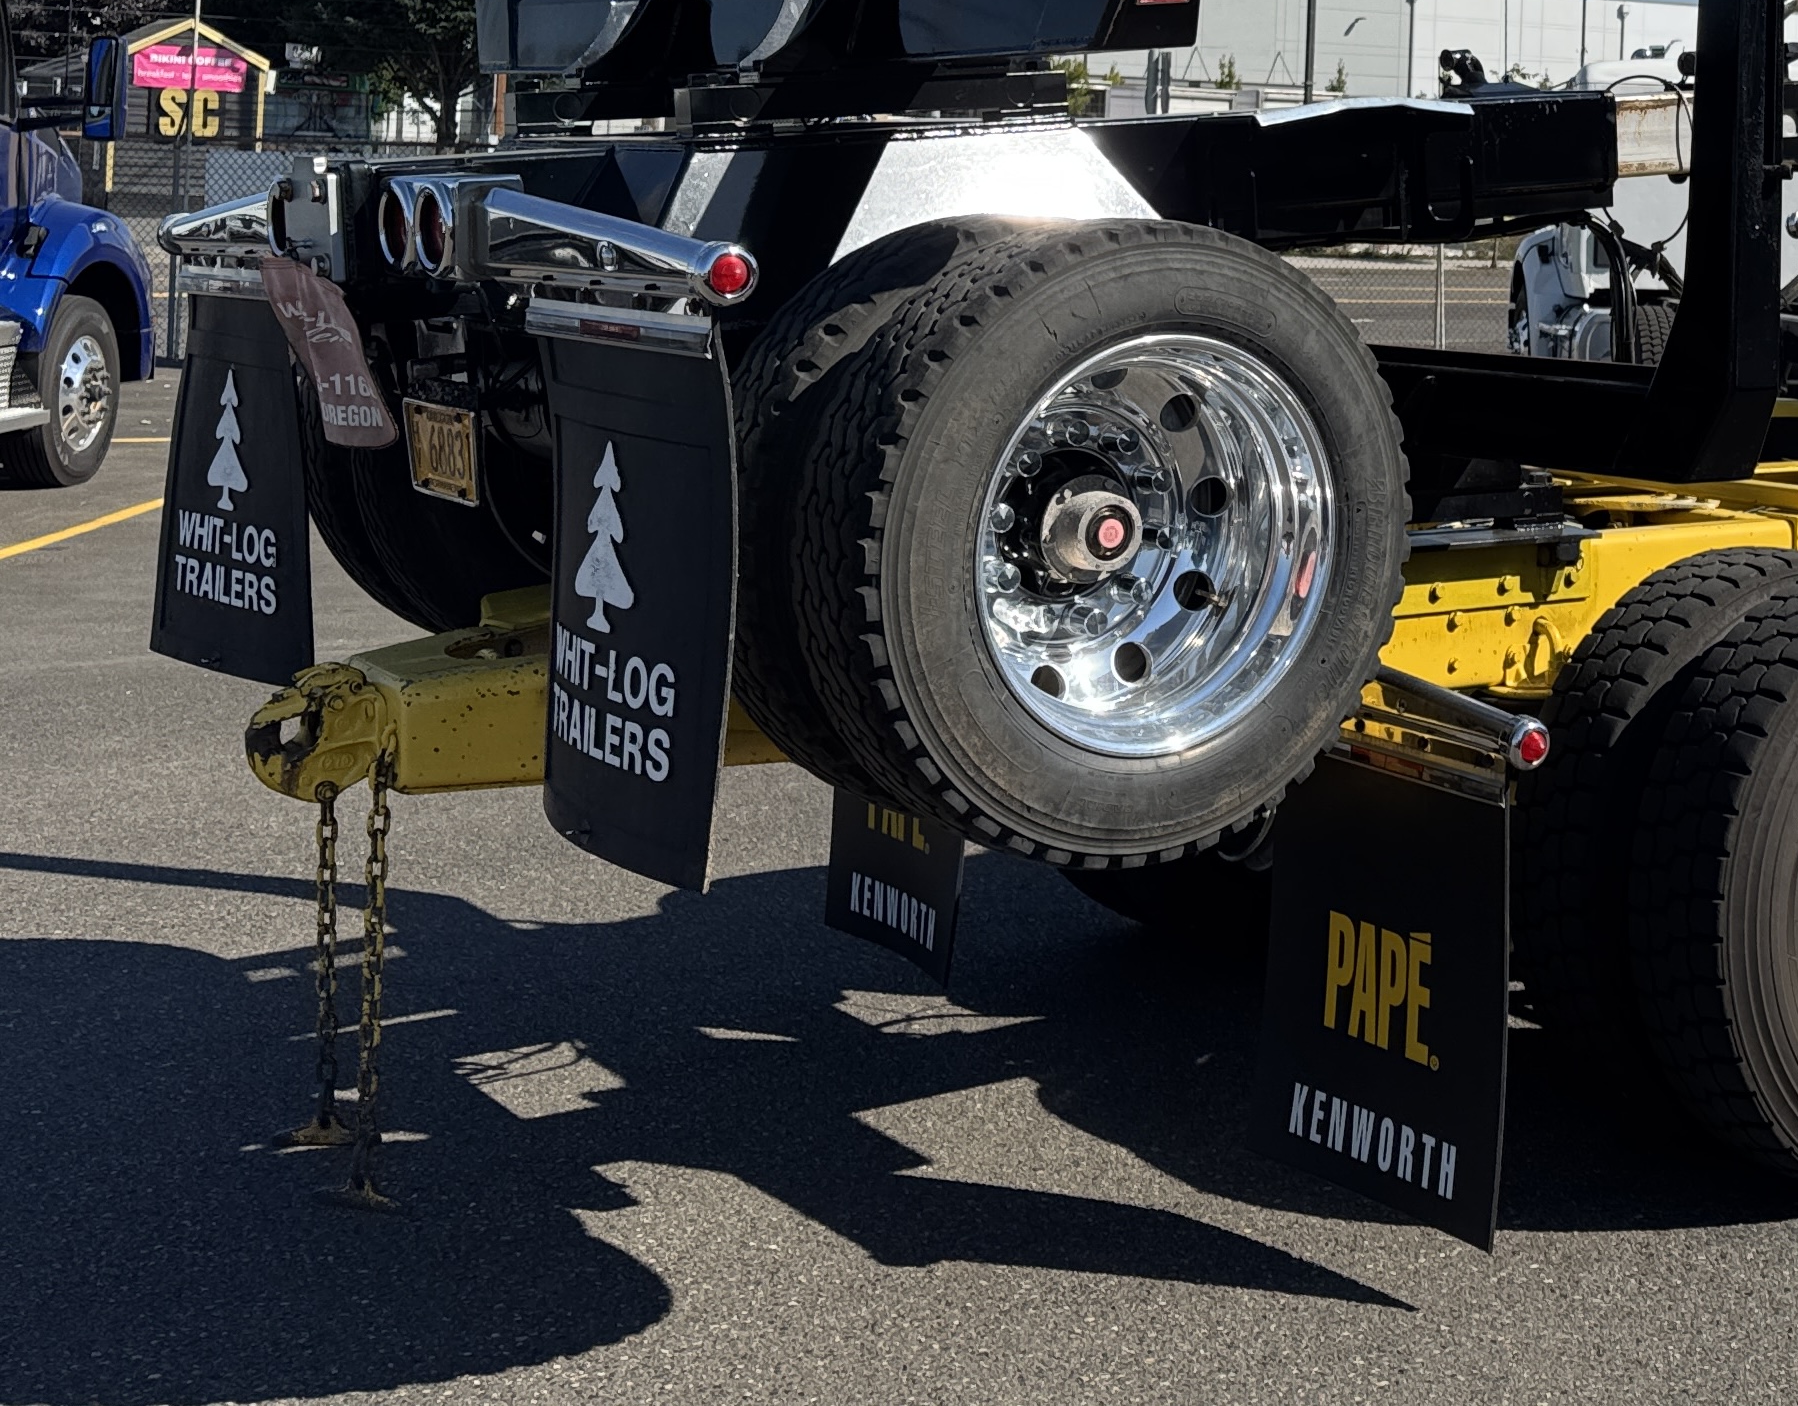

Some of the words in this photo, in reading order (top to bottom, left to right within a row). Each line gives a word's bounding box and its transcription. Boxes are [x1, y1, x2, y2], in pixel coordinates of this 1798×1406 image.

[149, 53, 186, 65] BIKINI
[322, 402, 383, 427] OREGON
[178, 509, 277, 569] WHIT-LOG
[175, 554, 277, 615] TRAILERS
[556, 622, 676, 717] WHIT-LOG
[553, 681, 671, 782] TRAILERS
[850, 871, 936, 952] KENWORTH
[1323, 910, 1432, 1067] PAPÉ
[1288, 1082, 1457, 1200] KENWORTH
